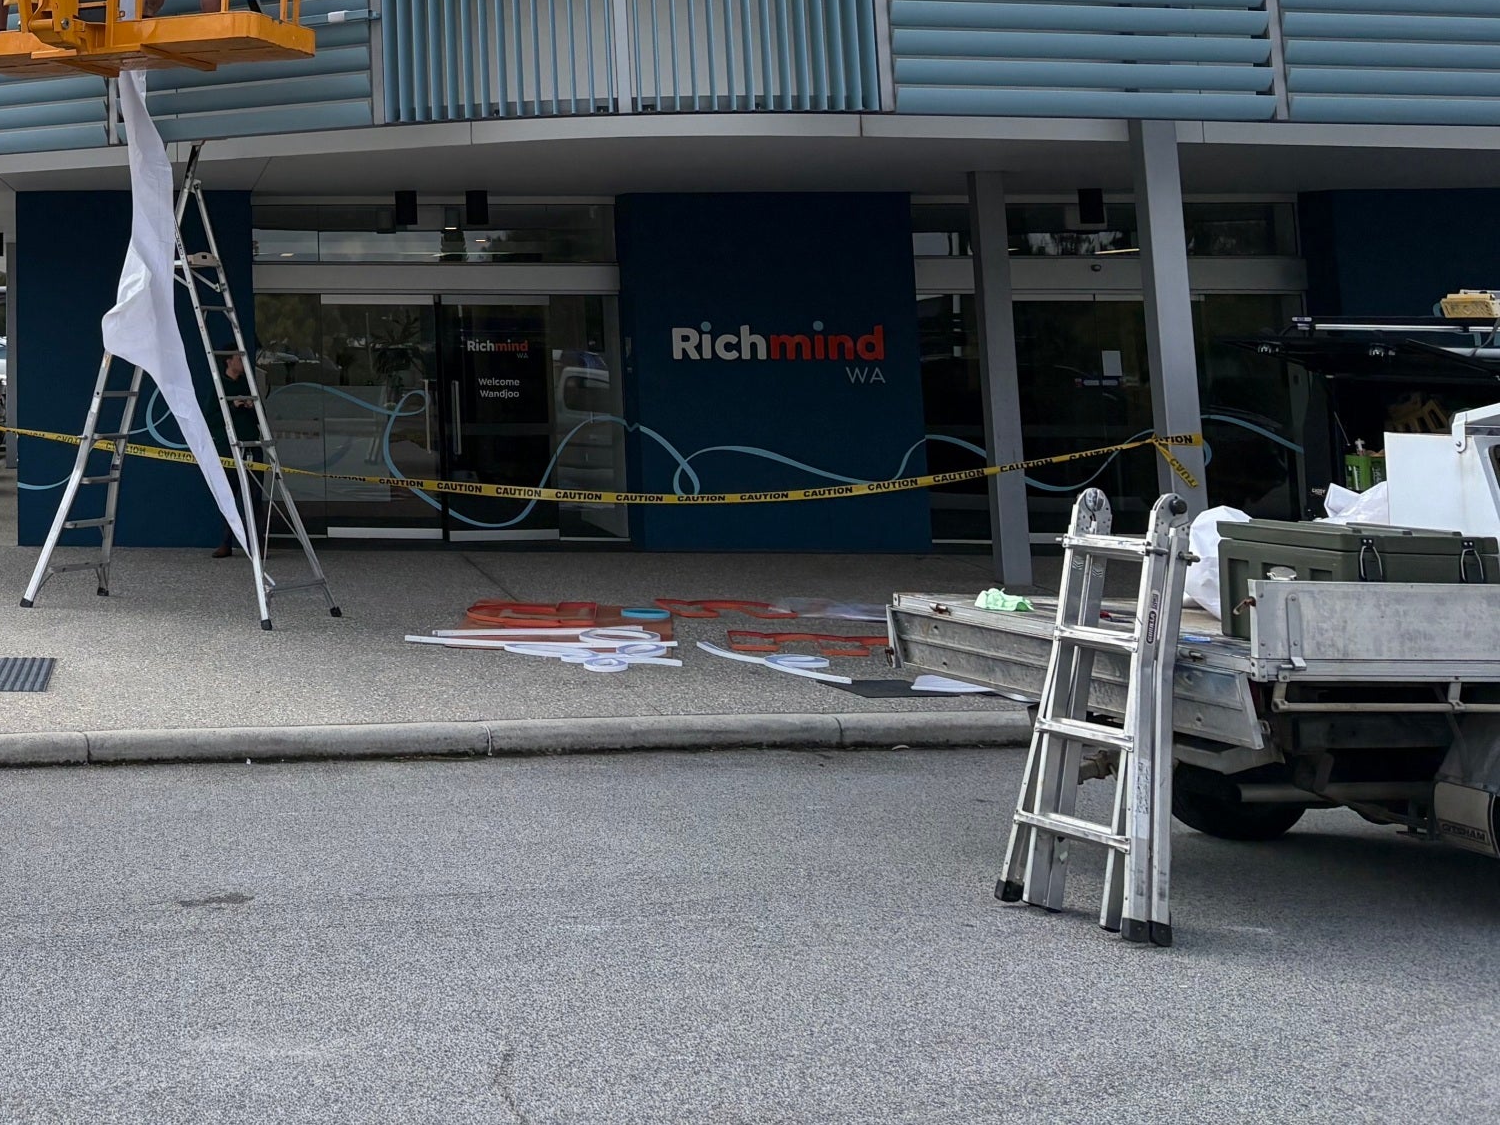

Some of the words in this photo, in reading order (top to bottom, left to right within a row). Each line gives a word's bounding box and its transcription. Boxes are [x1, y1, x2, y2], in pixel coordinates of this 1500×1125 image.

[466, 338, 529, 352] Richmind
[672, 321, 885, 360] Richmind
[478, 377, 520, 386] Welcome
[845, 366, 886, 384] WA
[479, 389, 520, 399] Wandjoo
[436, 482, 483, 493] CAUTION
[495, 487, 542, 498] CAUTION
[555, 491, 602, 501] CAUTION
[615, 494, 664, 502] CAUTION
[739, 492, 789, 501] CAUTION
[803, 486, 853, 498] CAUTION
[867, 478, 919, 491] CAUTION
[932, 469, 985, 483] CAUTION
